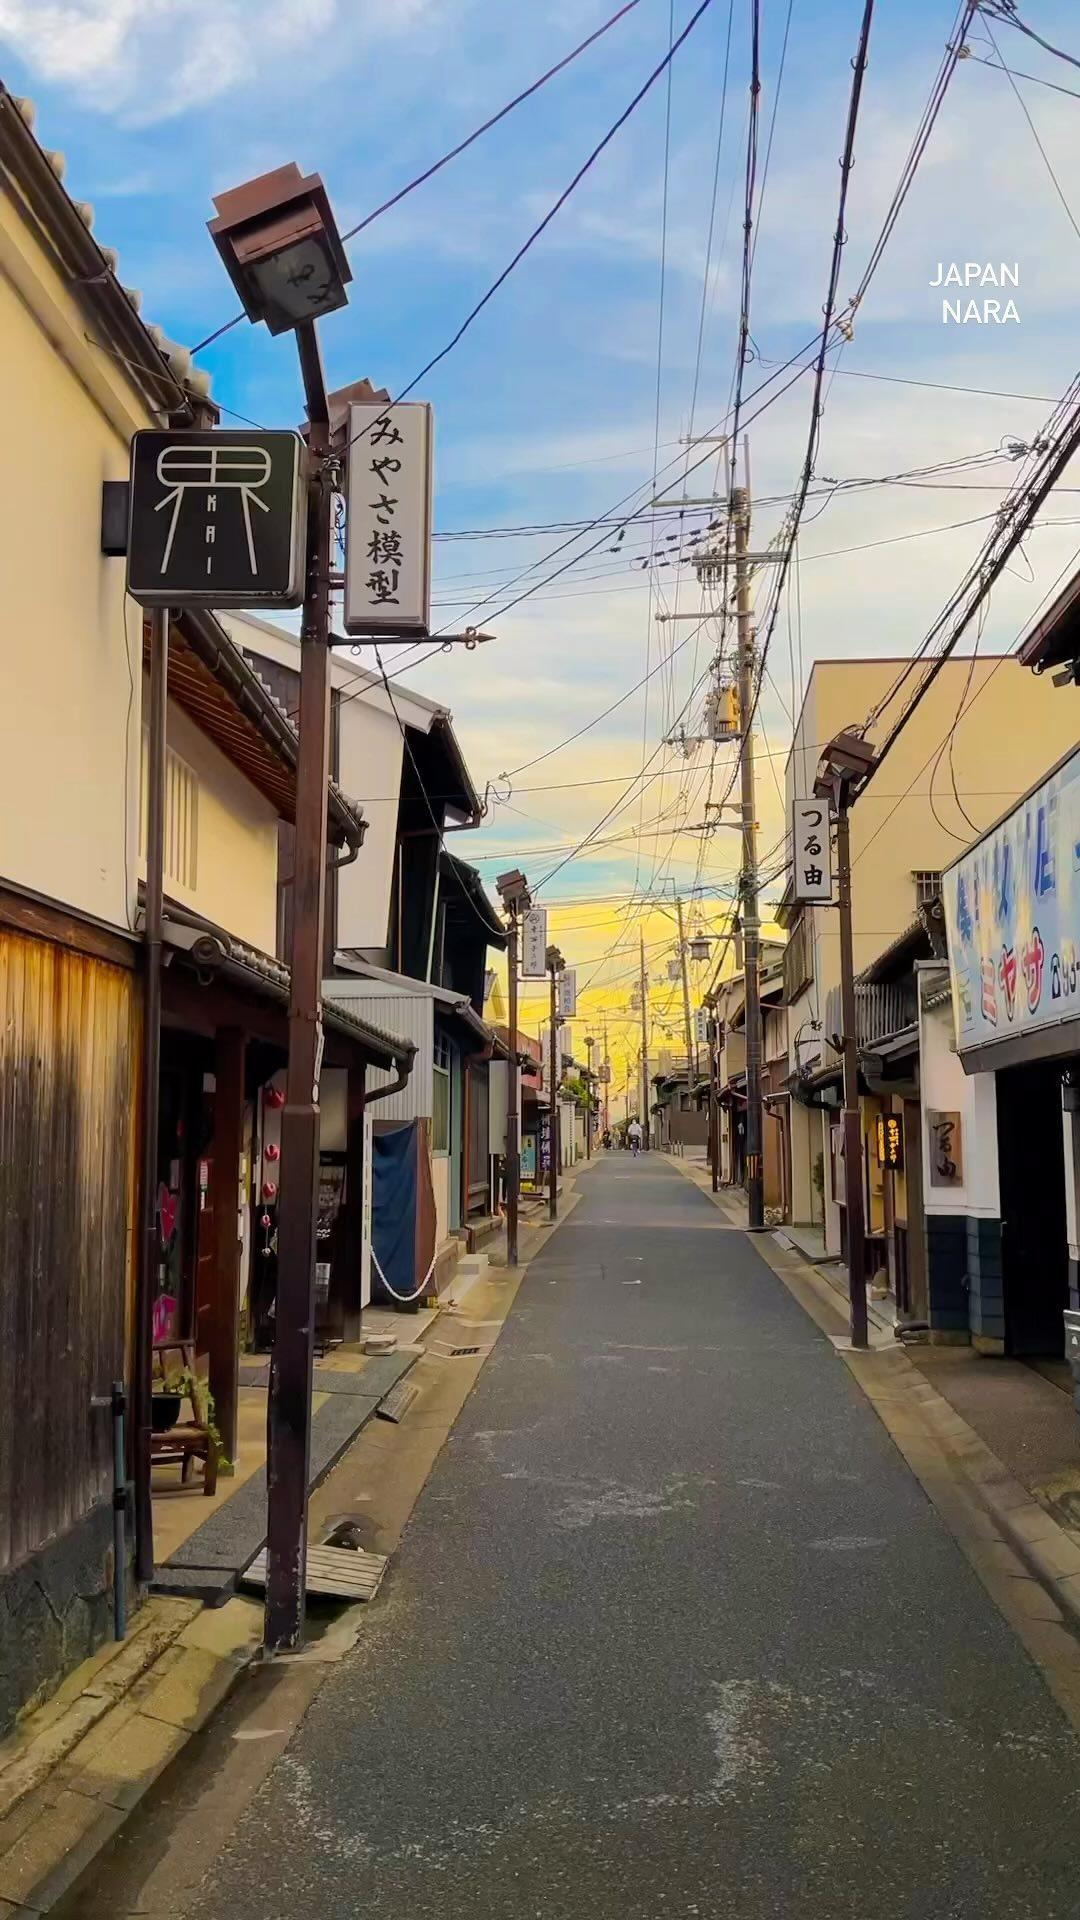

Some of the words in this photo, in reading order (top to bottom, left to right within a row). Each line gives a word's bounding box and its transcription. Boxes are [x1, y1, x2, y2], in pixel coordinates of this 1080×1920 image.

[365, 416, 404, 605] みやさ模型
[801, 810, 823, 886] つる由
[981, 926, 1044, 1027] ミヤサ
